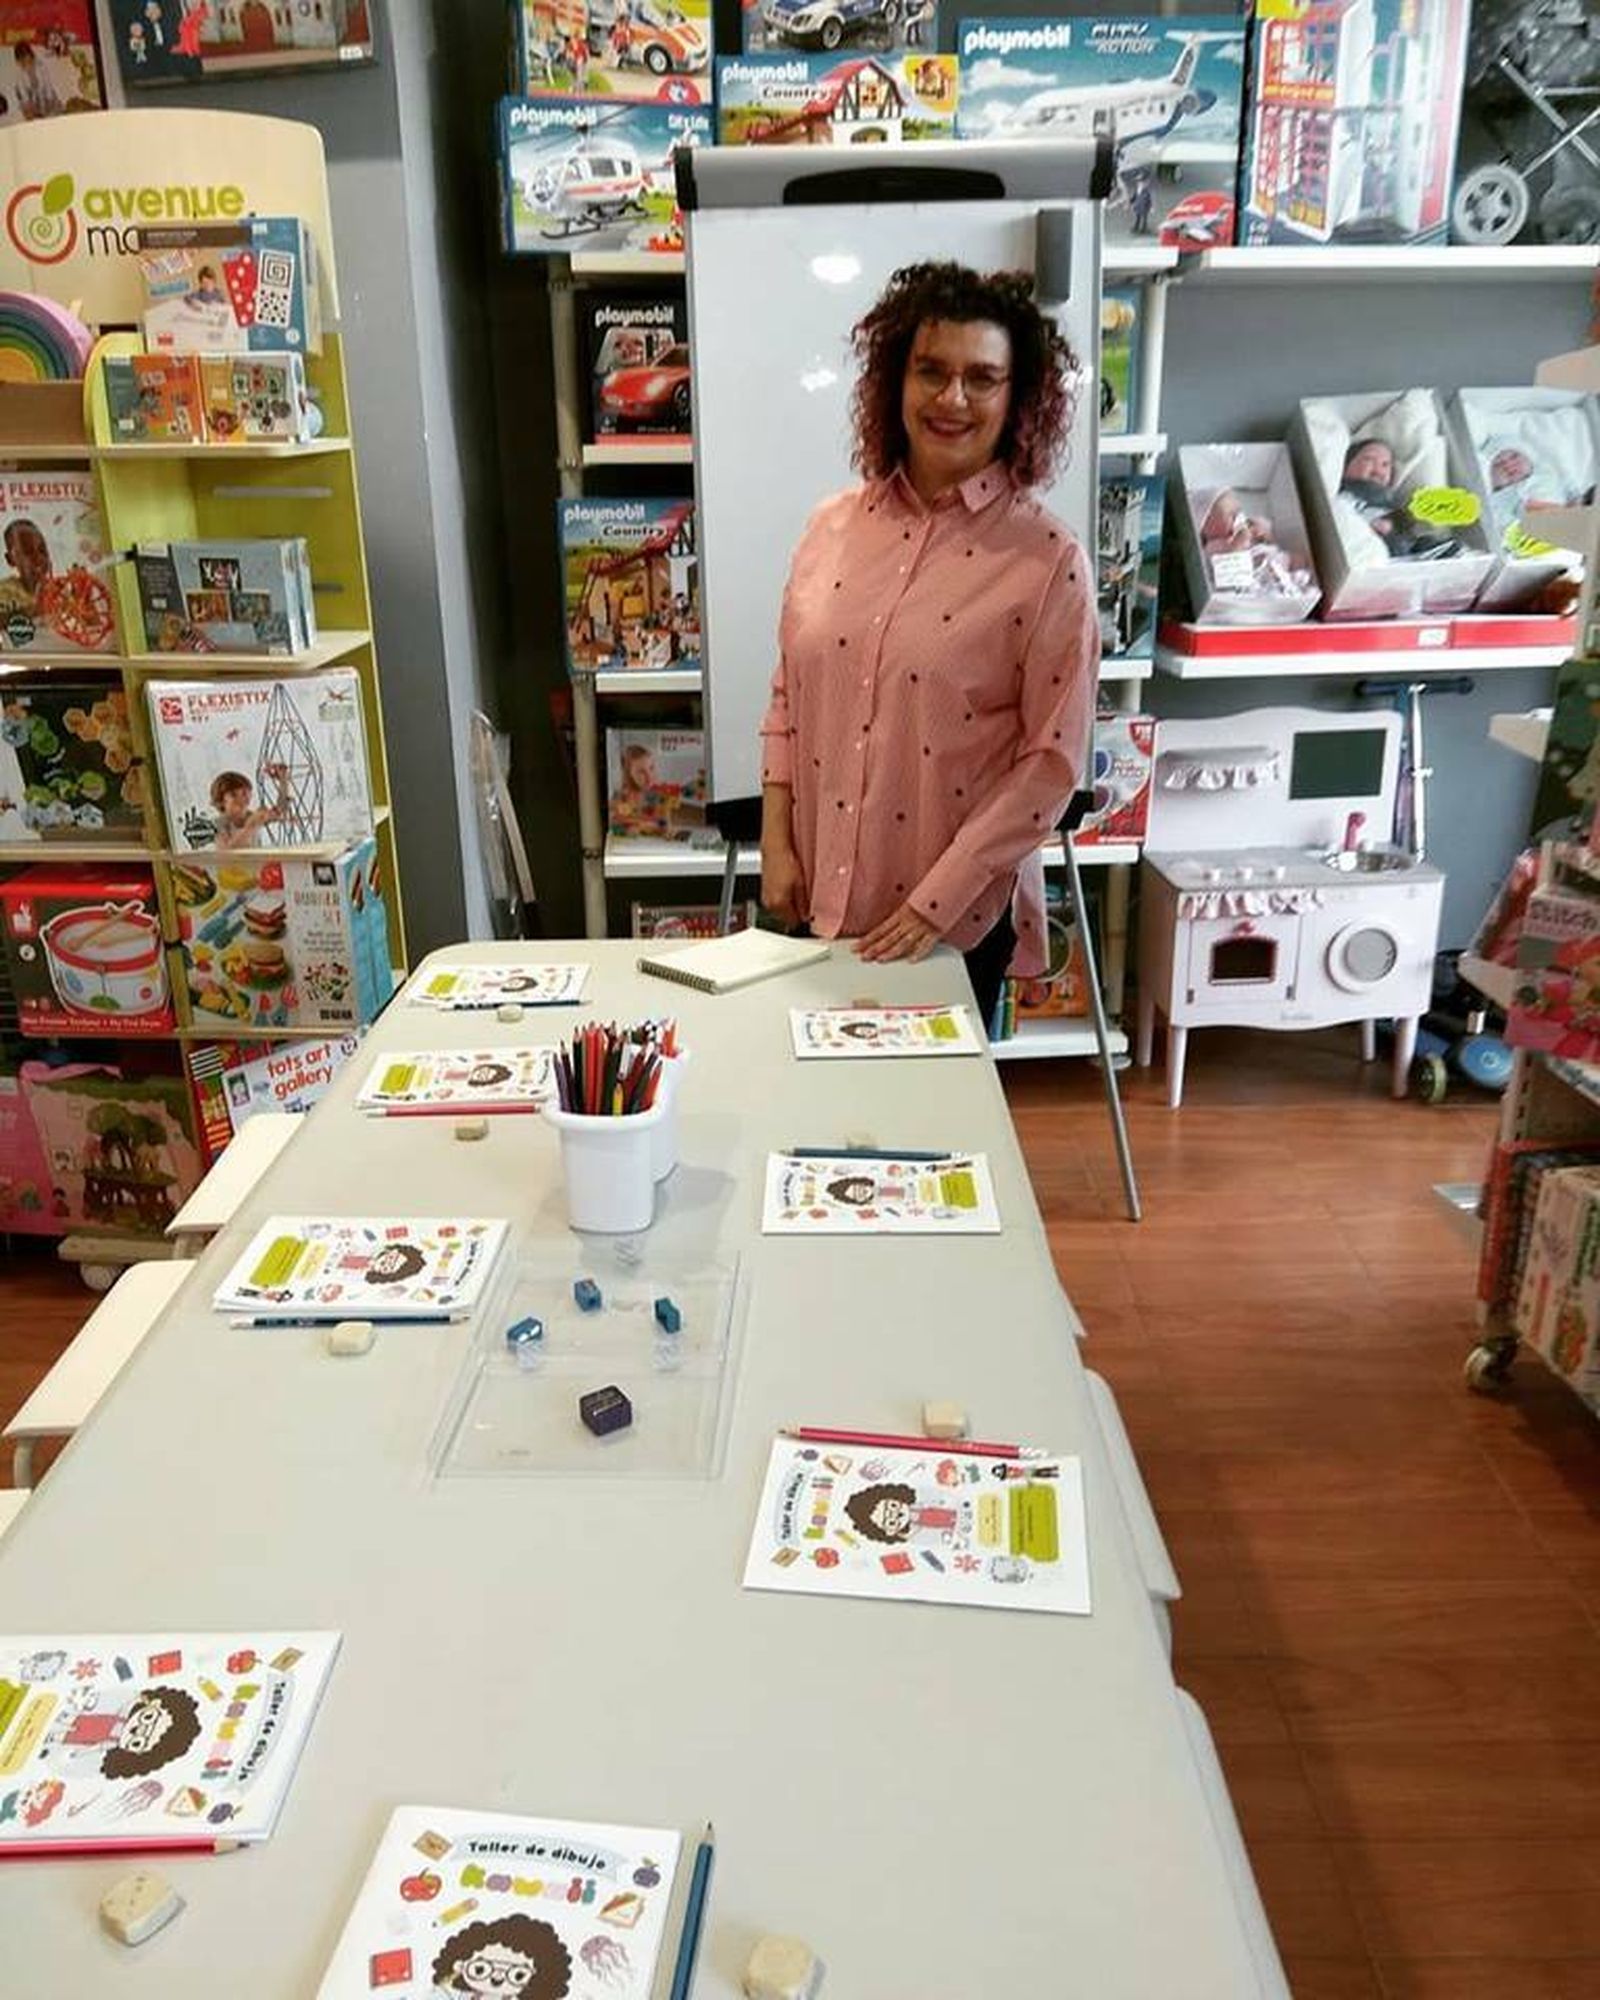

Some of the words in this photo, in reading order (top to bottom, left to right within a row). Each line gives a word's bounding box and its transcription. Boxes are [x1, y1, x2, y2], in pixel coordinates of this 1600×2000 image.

[964, 24, 1071, 55] playmobil
[722, 61, 808, 85] playmobil
[762, 86, 829, 99] Country
[510, 105, 597, 128] playmobil
[83, 186, 244, 220] avenue
[595, 305, 674, 328] playmobil
[9, 482, 86, 497] FLEXISTIX
[564, 503, 645, 525] playmobil
[603, 524, 666, 538] Country
[187, 691, 270, 708] FLEXISTIX
[266, 1055, 303, 1079] tots
[305, 1043, 331, 1064] art
[274, 1065, 334, 1101] gallery
[468, 1840, 519, 1853] Taller
[525, 1844, 546, 1856] de
[551, 1847, 607, 1869] dibujo
